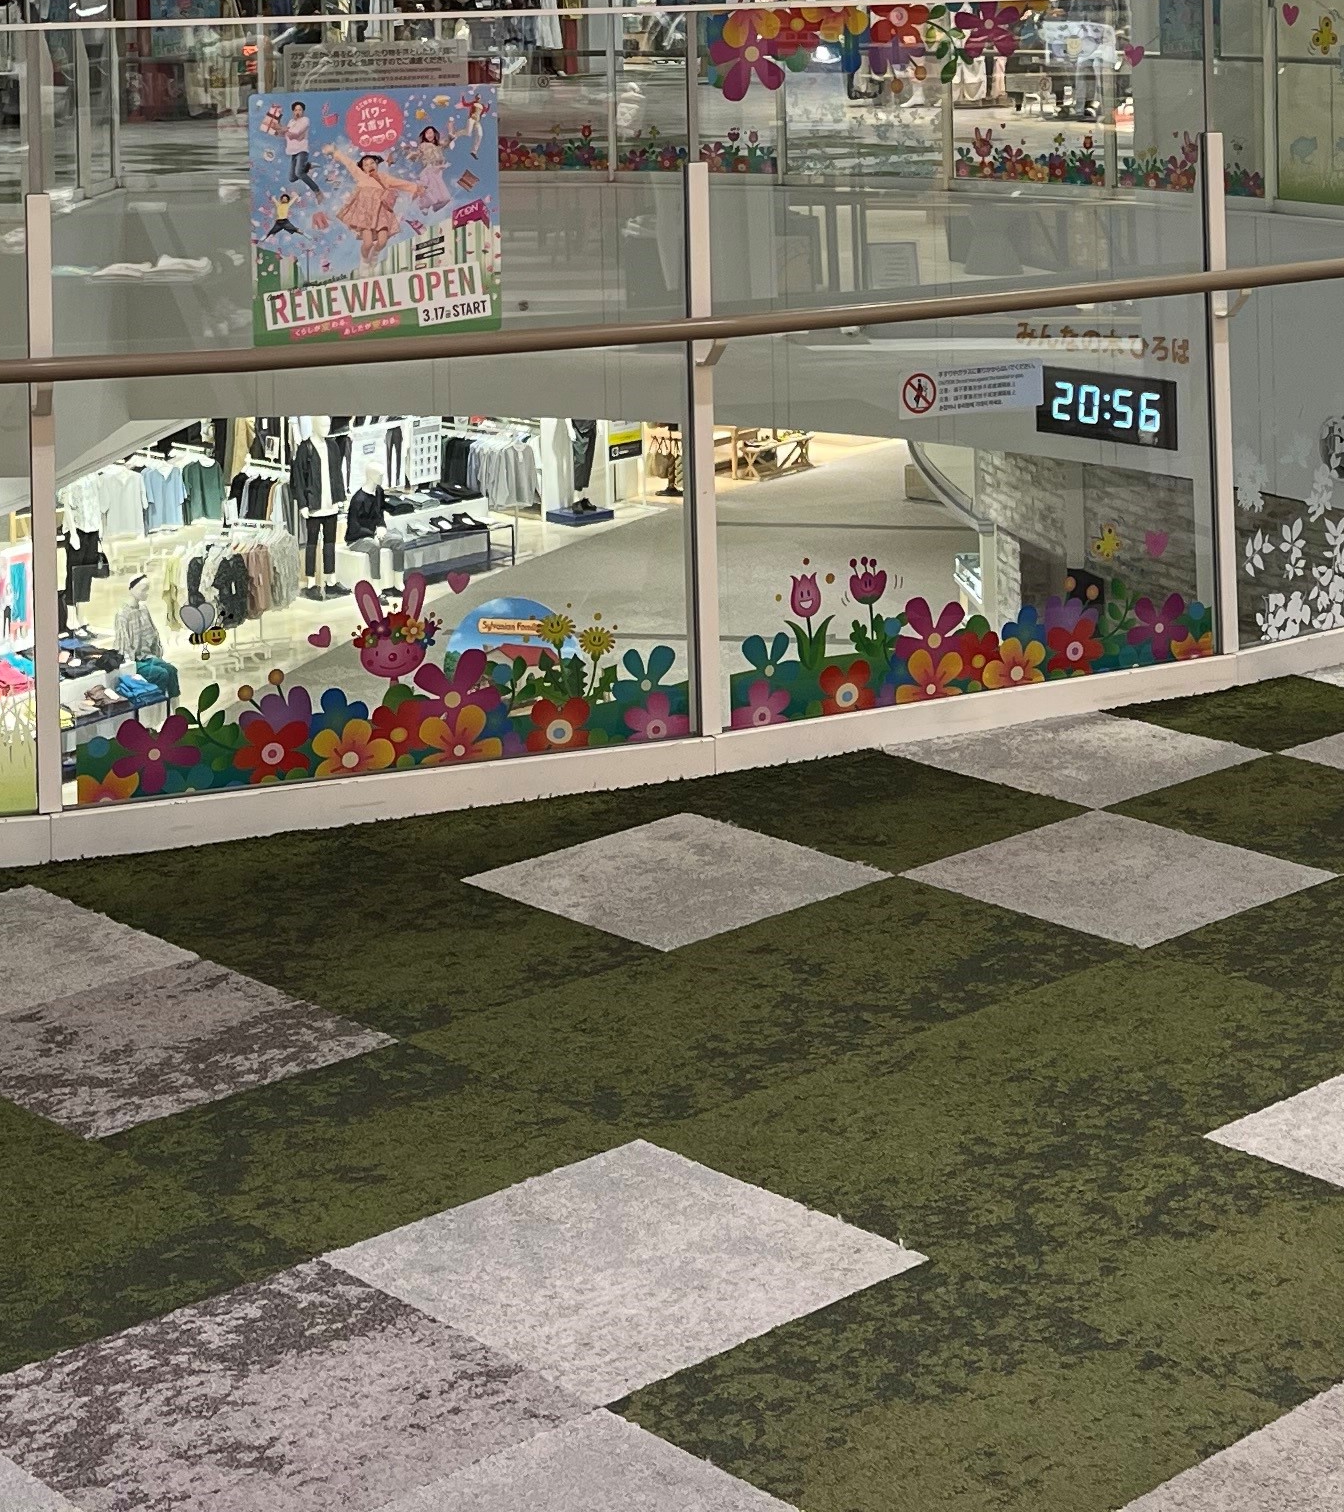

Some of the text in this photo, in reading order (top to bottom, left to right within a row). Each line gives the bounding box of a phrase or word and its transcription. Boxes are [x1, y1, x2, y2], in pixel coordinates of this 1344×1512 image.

[270, 265, 477, 326] RENEWAL OPEN
[452, 299, 488, 318] START
[1052, 380, 1161, 433] 20:56
